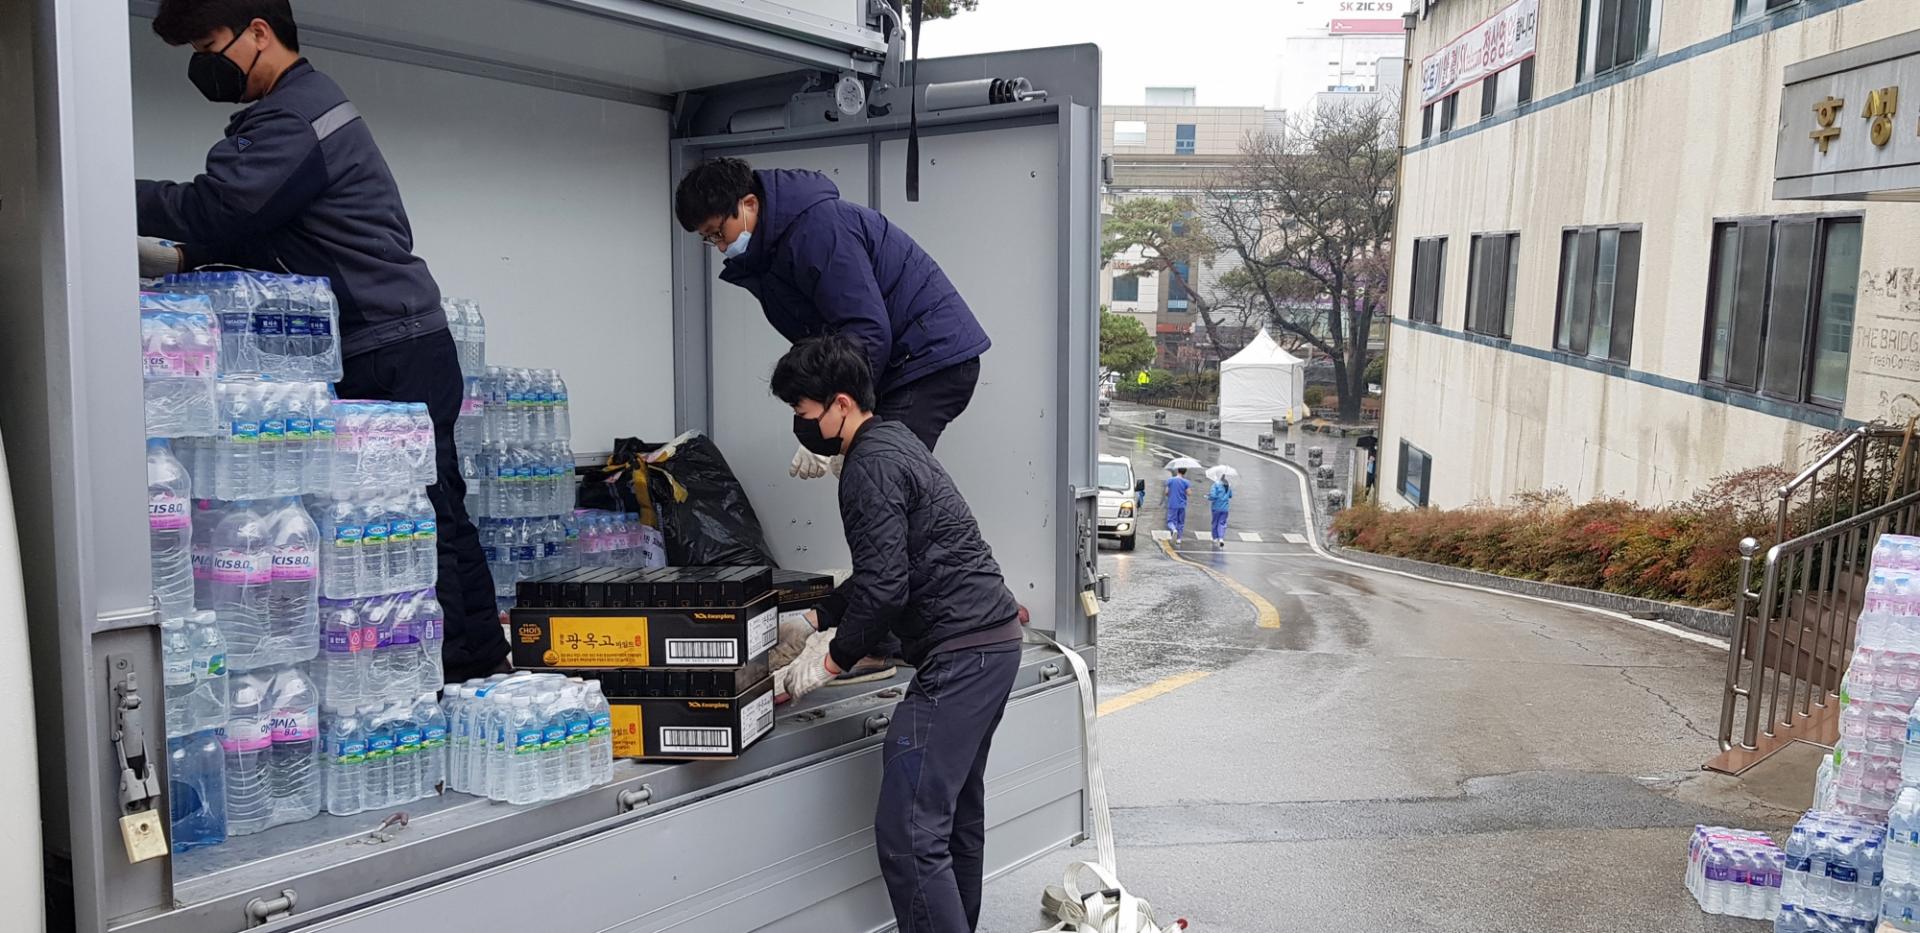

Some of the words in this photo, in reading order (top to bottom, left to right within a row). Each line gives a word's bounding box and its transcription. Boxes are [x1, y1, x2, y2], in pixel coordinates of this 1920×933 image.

[1340, 2, 1354, 11] SK
[1356, 2, 1375, 11] ZIC
[1377, 2, 1393, 11] X9
[1809, 86, 1920, 155] 후생
[1856, 325, 1878, 349] THE
[1880, 328, 1920, 353] BRIDG
[168, 502, 182, 514] 8.0
[214, 557, 233, 569] ICIS
[233, 558, 249, 569] 8.0
[271, 554, 294, 566] ICIS
[295, 555, 309, 565] 8.0
[566, 633, 615, 650] 광옥고
